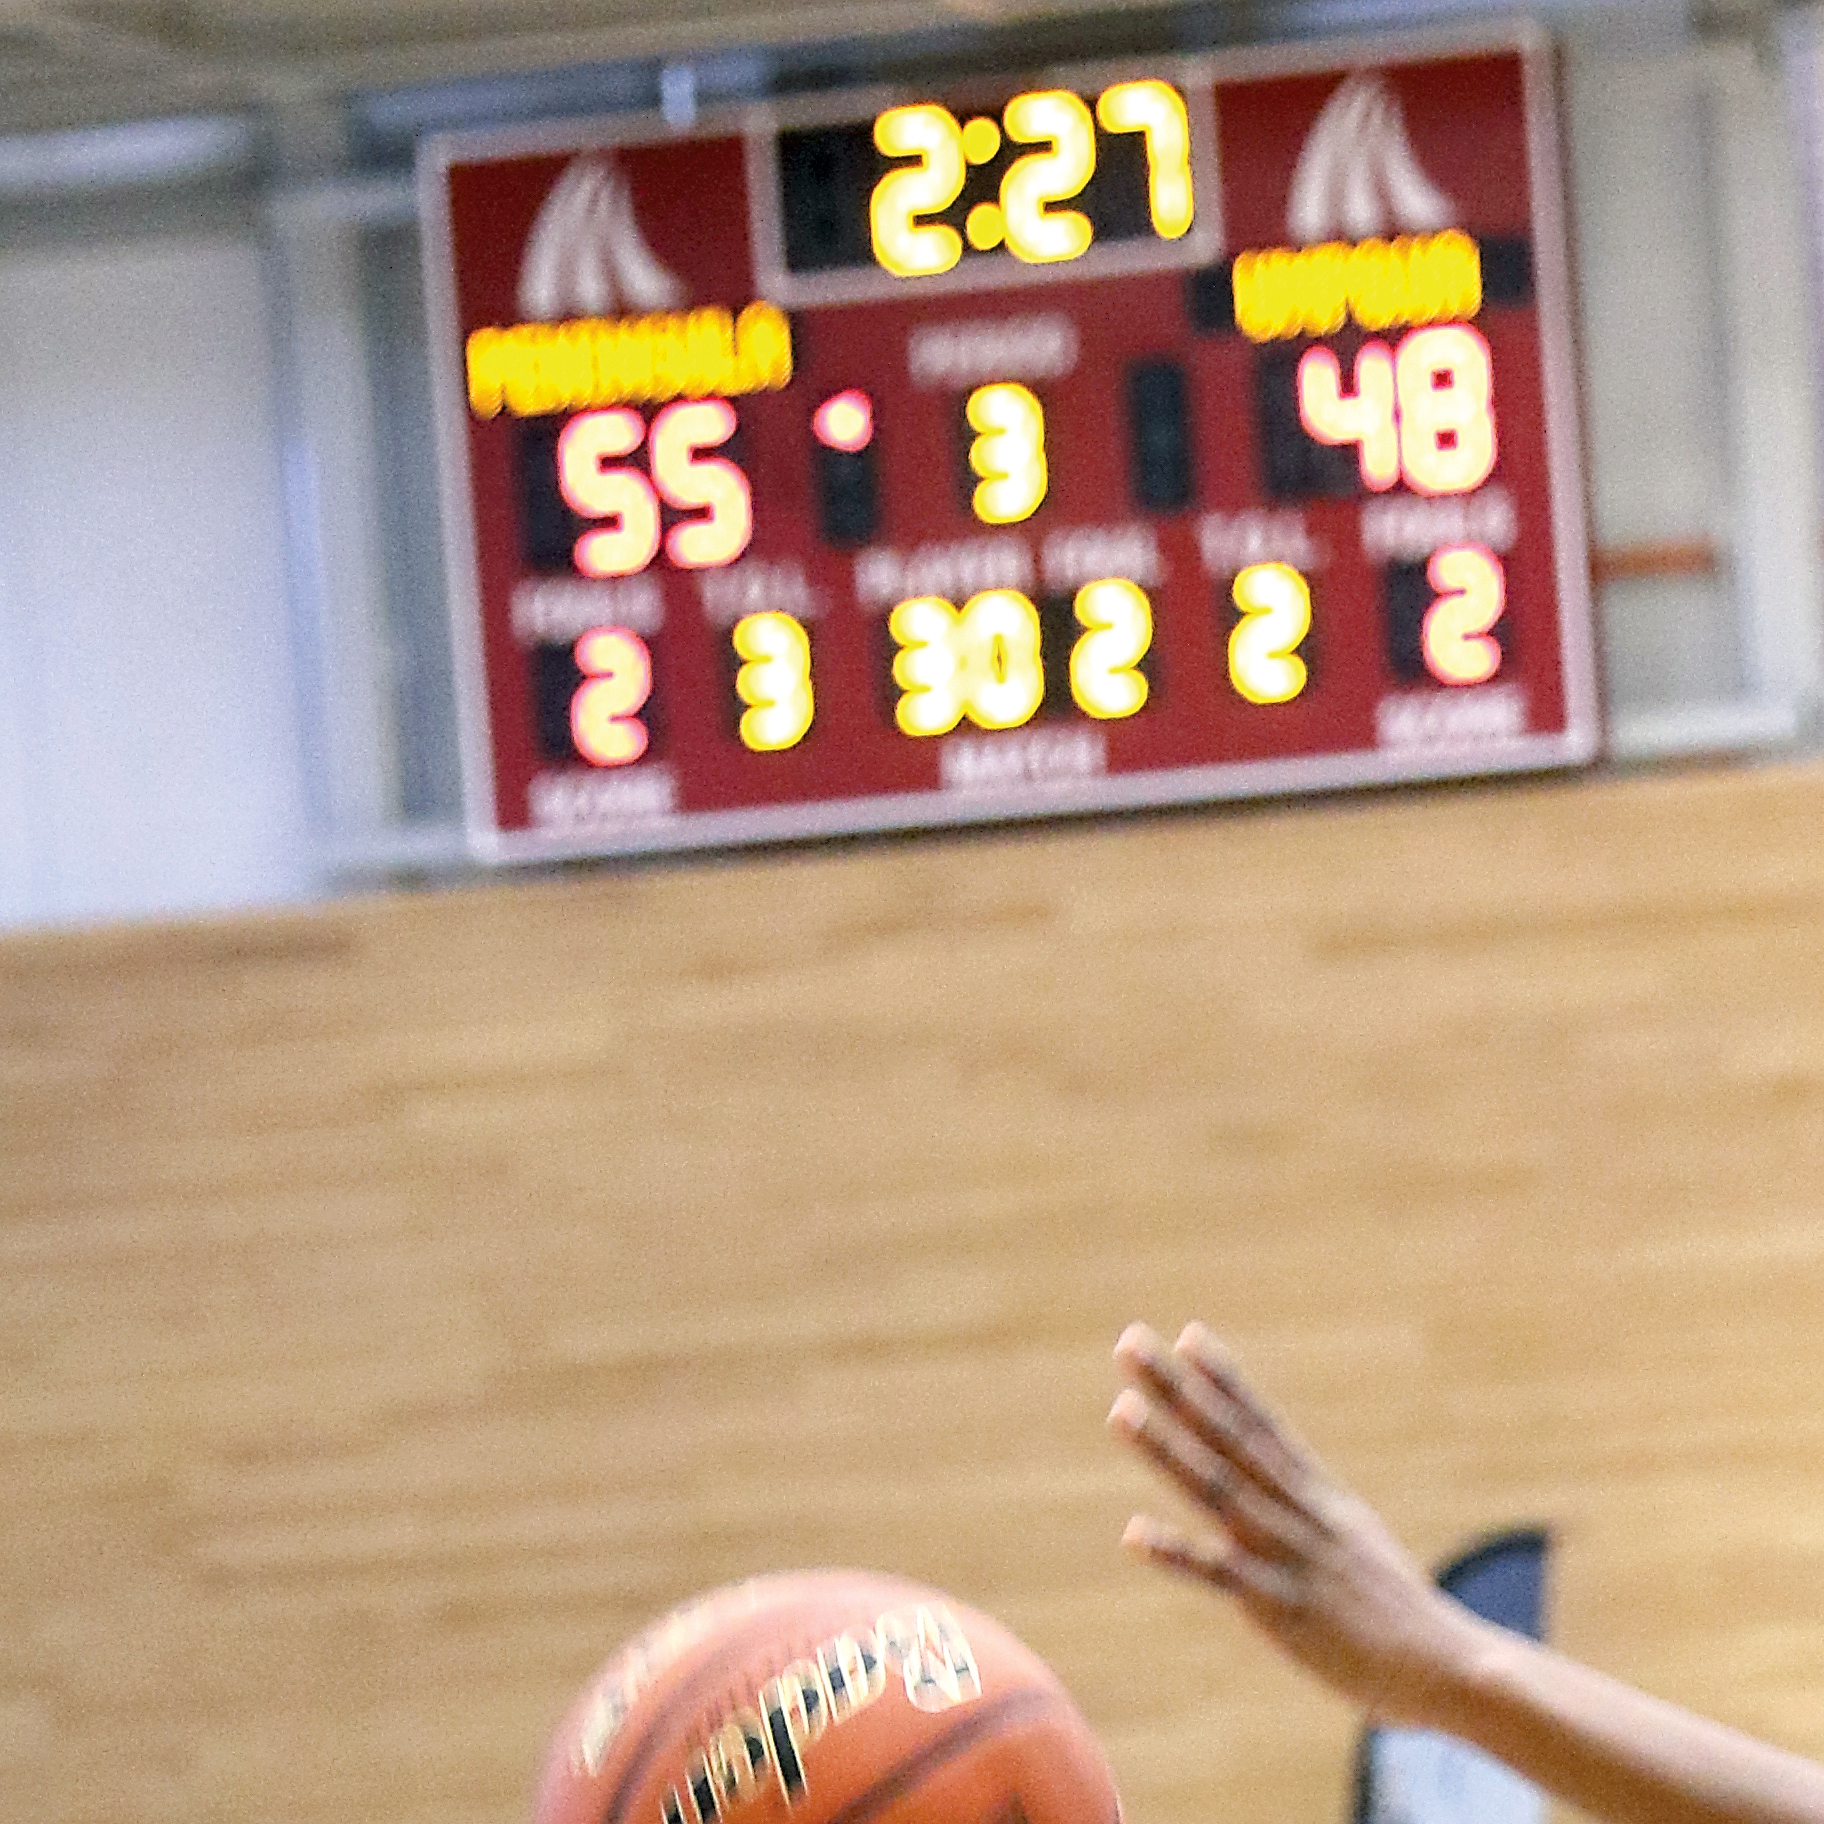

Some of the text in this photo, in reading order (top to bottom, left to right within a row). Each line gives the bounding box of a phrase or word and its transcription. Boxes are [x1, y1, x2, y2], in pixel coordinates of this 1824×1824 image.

[871, 79, 1194, 277] 2:27
[966, 383, 1047, 524] 3
[1297, 324, 1497, 496] 48
[557, 398, 752, 578] 55
[733, 611, 814, 752] 3
[889, 588, 1044, 737] 30
[1070, 577, 1152, 719] 2
[1228, 561, 1310, 704] 2
[1424, 541, 1505, 685] 2
[570, 626, 652, 767] 2
